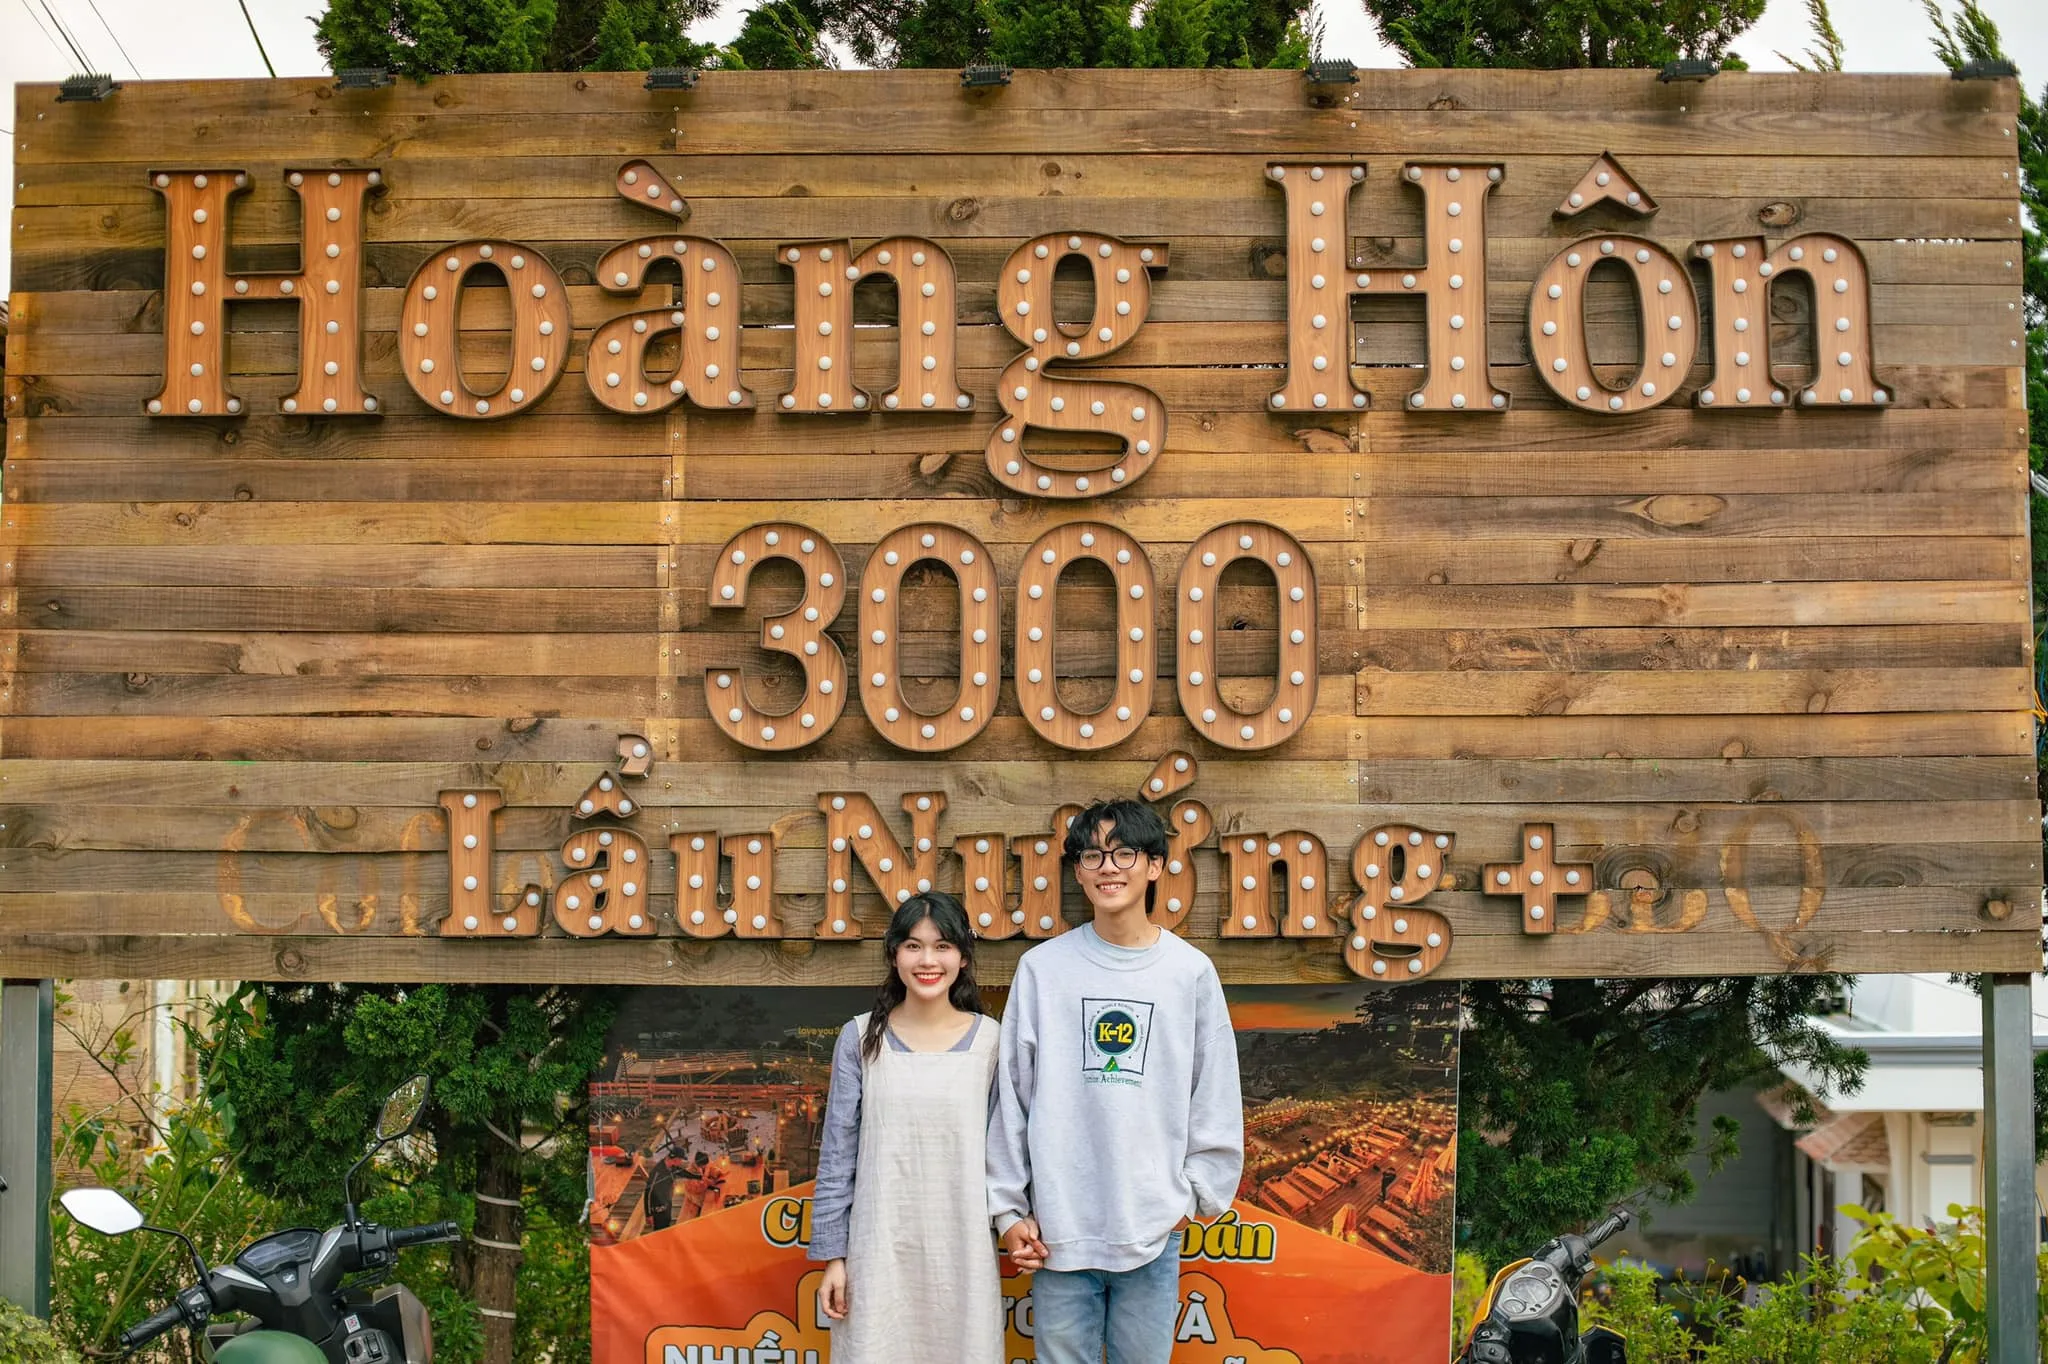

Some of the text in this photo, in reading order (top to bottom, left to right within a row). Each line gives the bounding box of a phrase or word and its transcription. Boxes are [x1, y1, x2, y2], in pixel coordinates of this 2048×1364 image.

[143, 150, 1894, 498] Hoàng Hôn
[705, 520, 1320, 752] 3000
[437, 732, 784, 939] Lẩu
[1097, 1022, 1134, 1045] K-12
[1174, 1290, 1217, 1343] À
